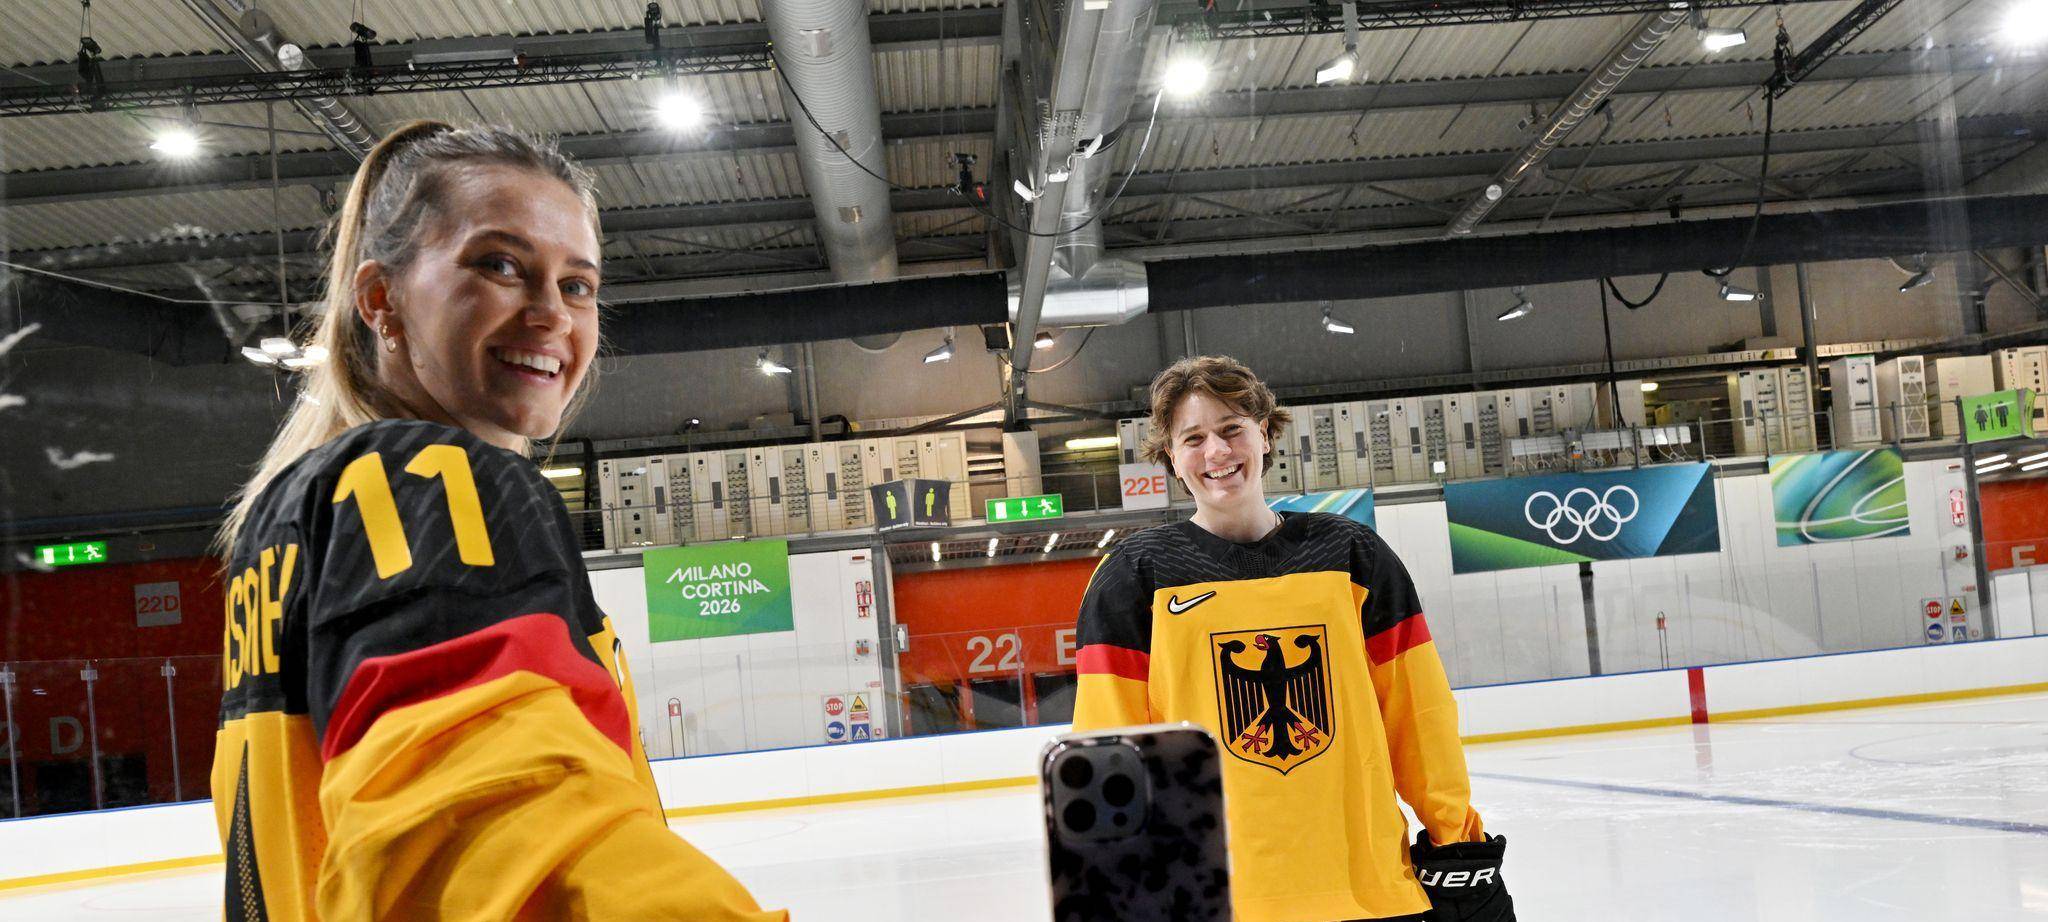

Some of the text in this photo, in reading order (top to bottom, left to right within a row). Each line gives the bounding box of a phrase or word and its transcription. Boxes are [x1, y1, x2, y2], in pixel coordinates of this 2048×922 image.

[1124, 475, 1166, 496] 22E
[332, 444, 496, 580] 11
[666, 562, 752, 584] MILANO
[682, 579, 771, 600] CORTINA
[138, 595, 179, 614] 22D
[699, 598, 741, 616] 2026
[966, 633, 1025, 673] 22
[826, 702, 843, 712] STOP
[49, 716, 84, 755] D
